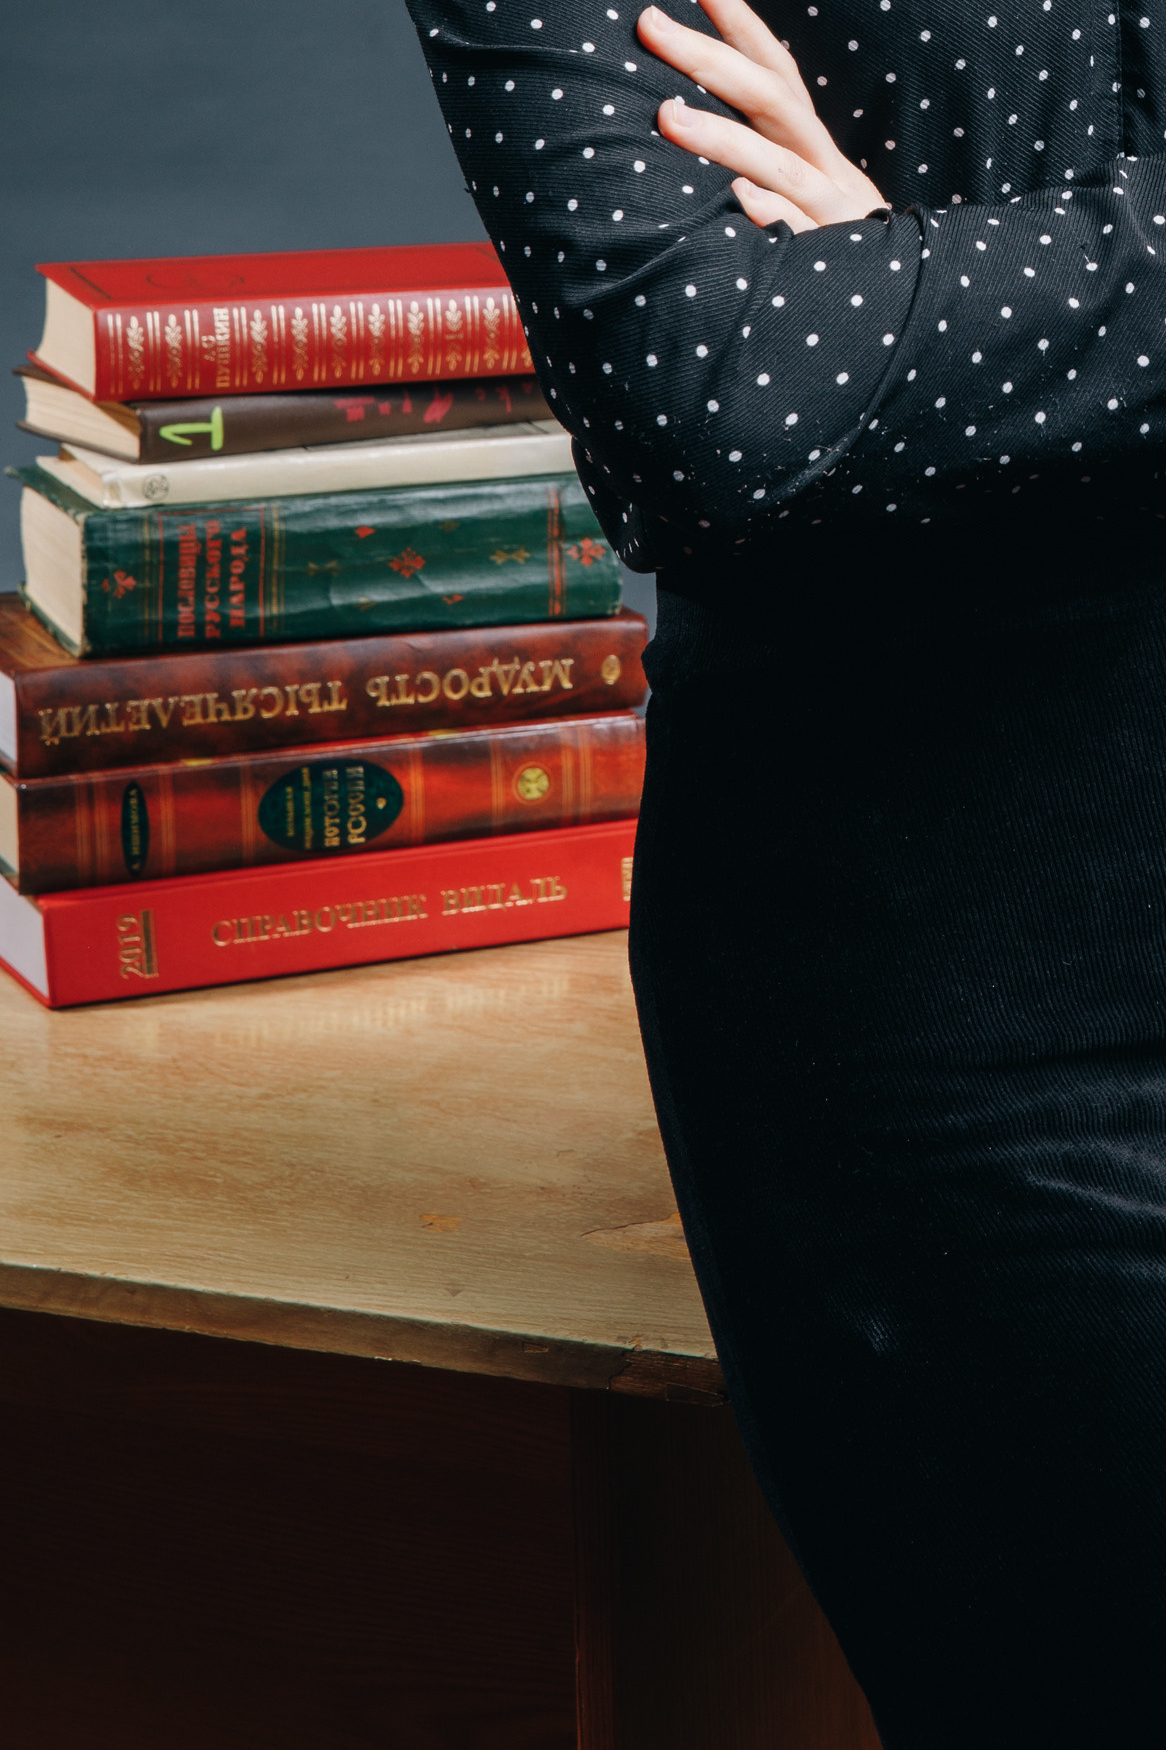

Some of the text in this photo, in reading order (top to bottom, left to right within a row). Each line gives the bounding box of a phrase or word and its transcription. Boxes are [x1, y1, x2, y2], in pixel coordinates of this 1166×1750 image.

[213, 306, 230, 388] ПУШКИН
[177, 522, 202, 639] ПОСЛОВИЦЫ
[205, 519, 222, 639] РУССКОГО
[229, 525, 250, 629] НАРОДА
[38, 657, 575, 746] МУДРОСТЬ ТЫСЯЧЕЛЕТИЙ
[323, 769, 341, 847] ИСТОРИЯ
[346, 766, 367, 844] РОССИИ
[116, 913, 143, 979] 2019
[211, 893, 428, 947] СПРАВОЧНИК
[441, 875, 568, 915] ВИДАЛЬ
